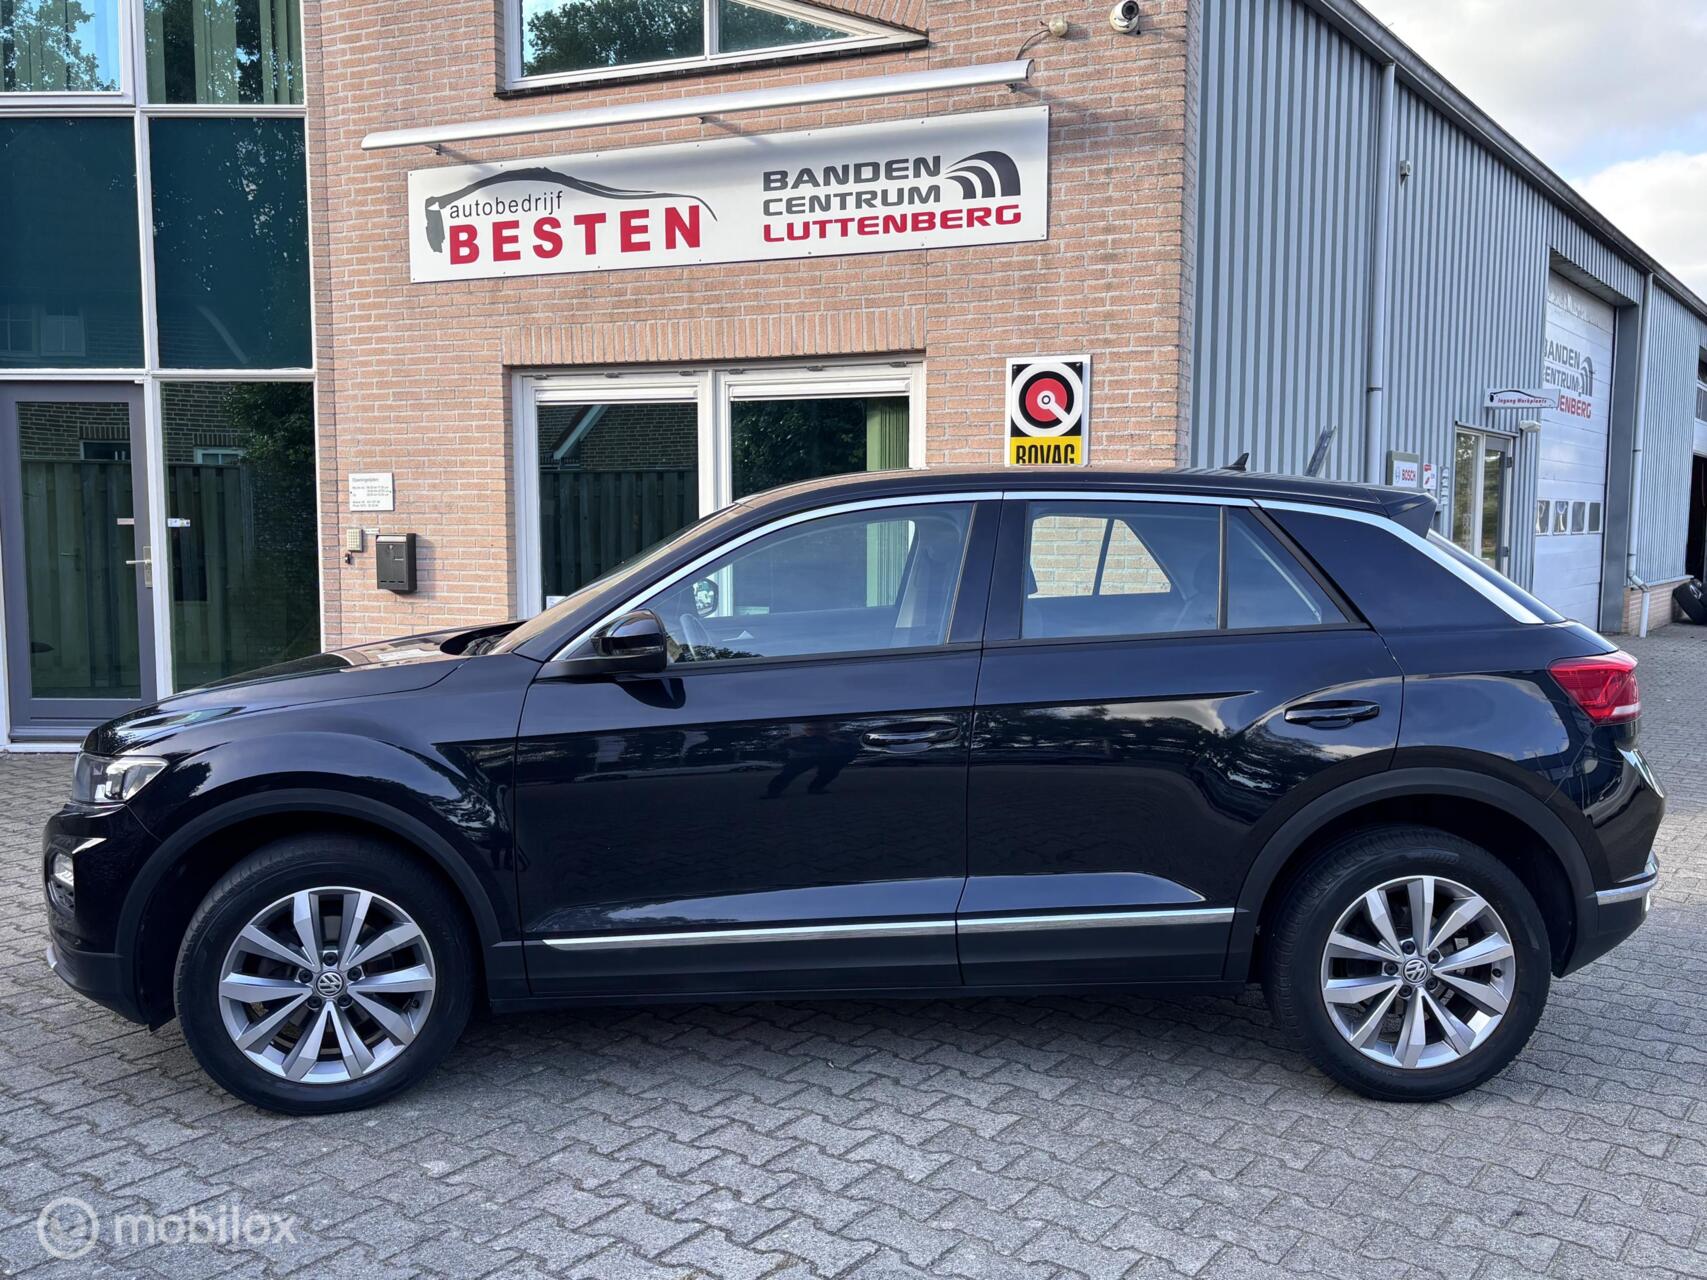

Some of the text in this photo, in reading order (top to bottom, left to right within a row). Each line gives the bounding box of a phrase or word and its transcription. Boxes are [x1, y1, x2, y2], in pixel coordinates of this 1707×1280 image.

[762, 155, 941, 192] BANDEN
[449, 190, 563, 219] autobedrijf
[762, 184, 941, 217] CENTRUM
[449, 204, 701, 265] BESTEN
[763, 203, 1022, 243] LUTTENBERG
[1544, 365, 1581, 393] ENTRUM
[1015, 443, 1075, 464] BOVAG
[1402, 468, 1417, 482] BOSCH
